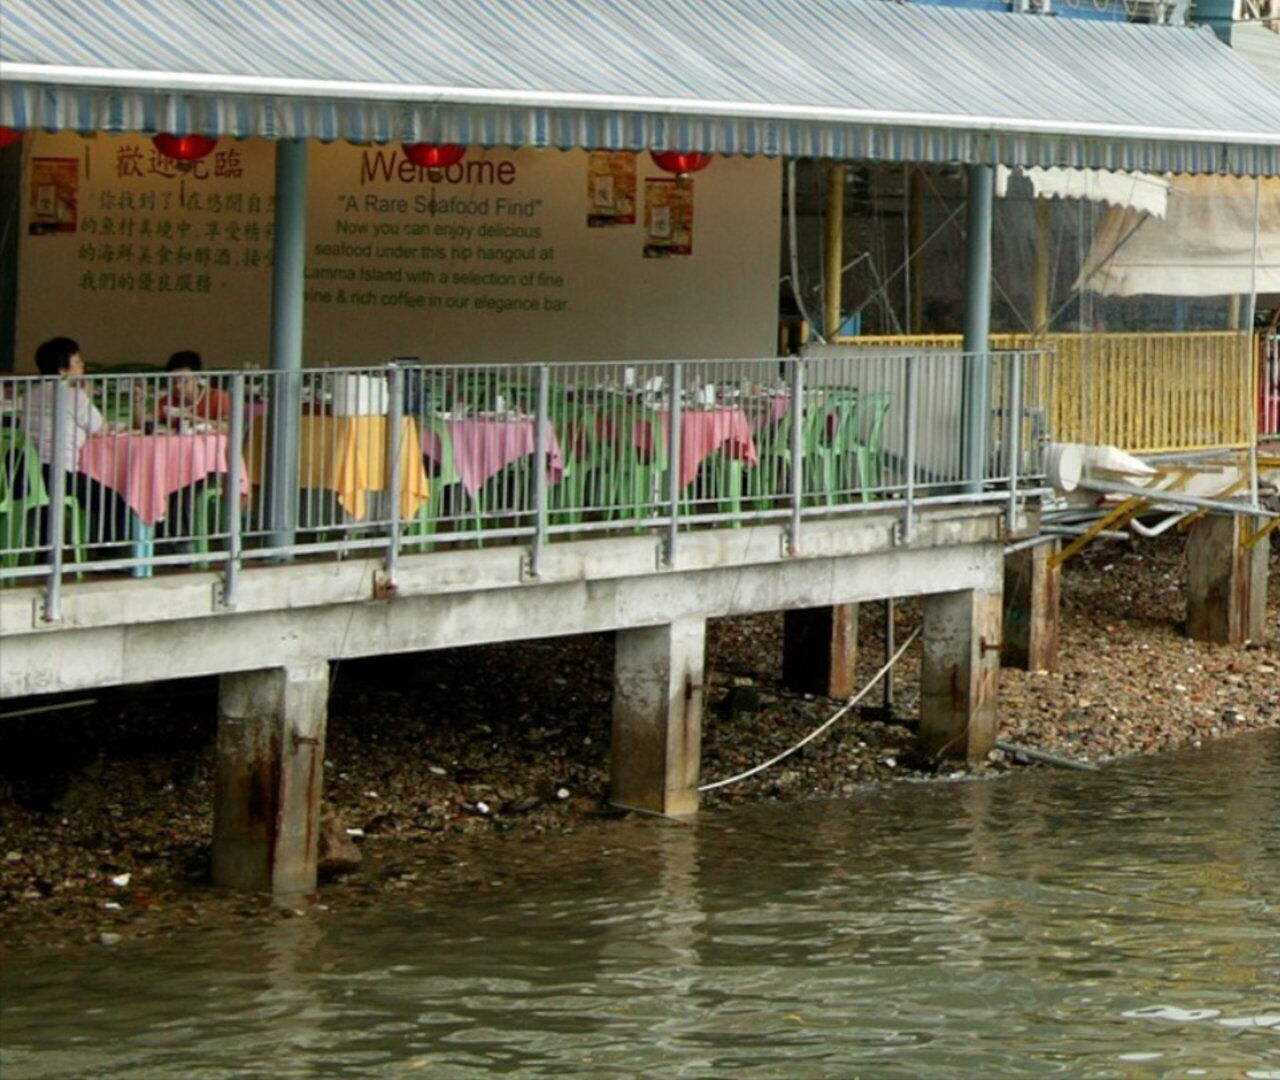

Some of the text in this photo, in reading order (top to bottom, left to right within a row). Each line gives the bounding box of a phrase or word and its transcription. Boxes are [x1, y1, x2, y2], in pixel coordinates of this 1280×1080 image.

[365, 195, 408, 213] Rare
[414, 195, 489, 216] Seafood
[336, 221, 542, 240] Now you can enjoy delicious
[315, 242, 554, 264] seafood under this hip hangout at
[359, 268, 402, 282] Island
[406, 269, 435, 283] with
[439, 273, 449, 284] a
[452, 272, 516, 285] selection
[520, 272, 534, 286] of
[537, 272, 564, 287] fine
[336, 290, 347, 304] &
[351, 290, 377, 305] rich
[382, 292, 426, 308] coffee
[429, 294, 442, 308] in
[445, 297, 470, 309] our
[474, 295, 541, 313] elegance
